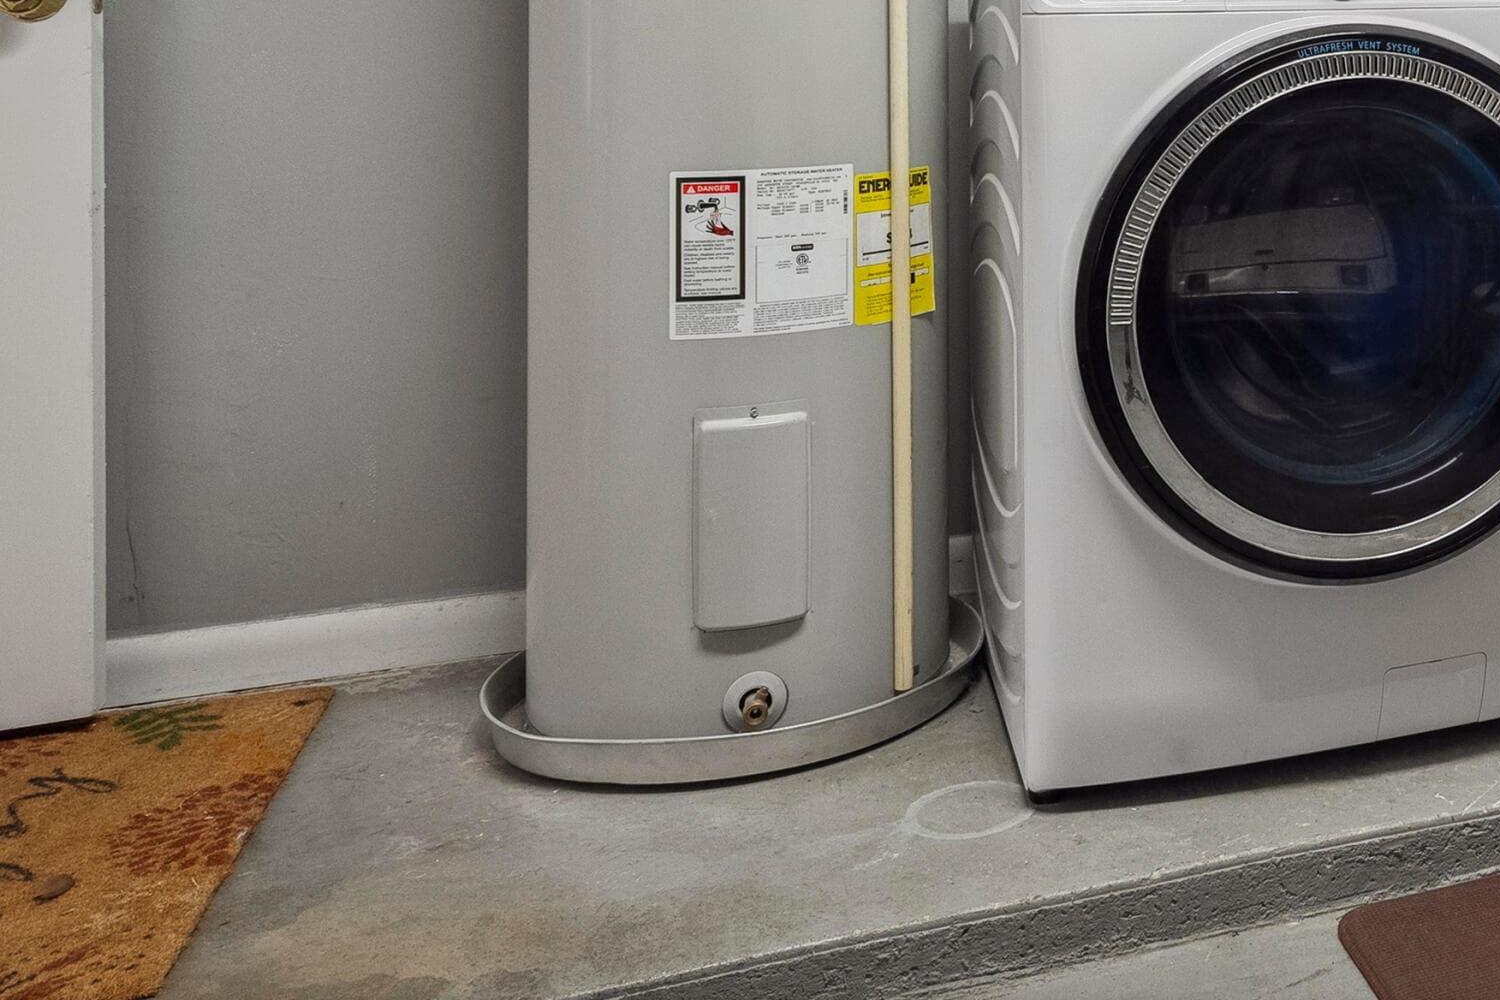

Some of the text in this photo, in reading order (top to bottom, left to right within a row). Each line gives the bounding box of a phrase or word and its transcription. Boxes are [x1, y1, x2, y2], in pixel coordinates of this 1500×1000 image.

[1296, 40, 1421, 58] ULTRAFRESH VENT SYSTEM
[696, 184, 731, 192] DANGER
